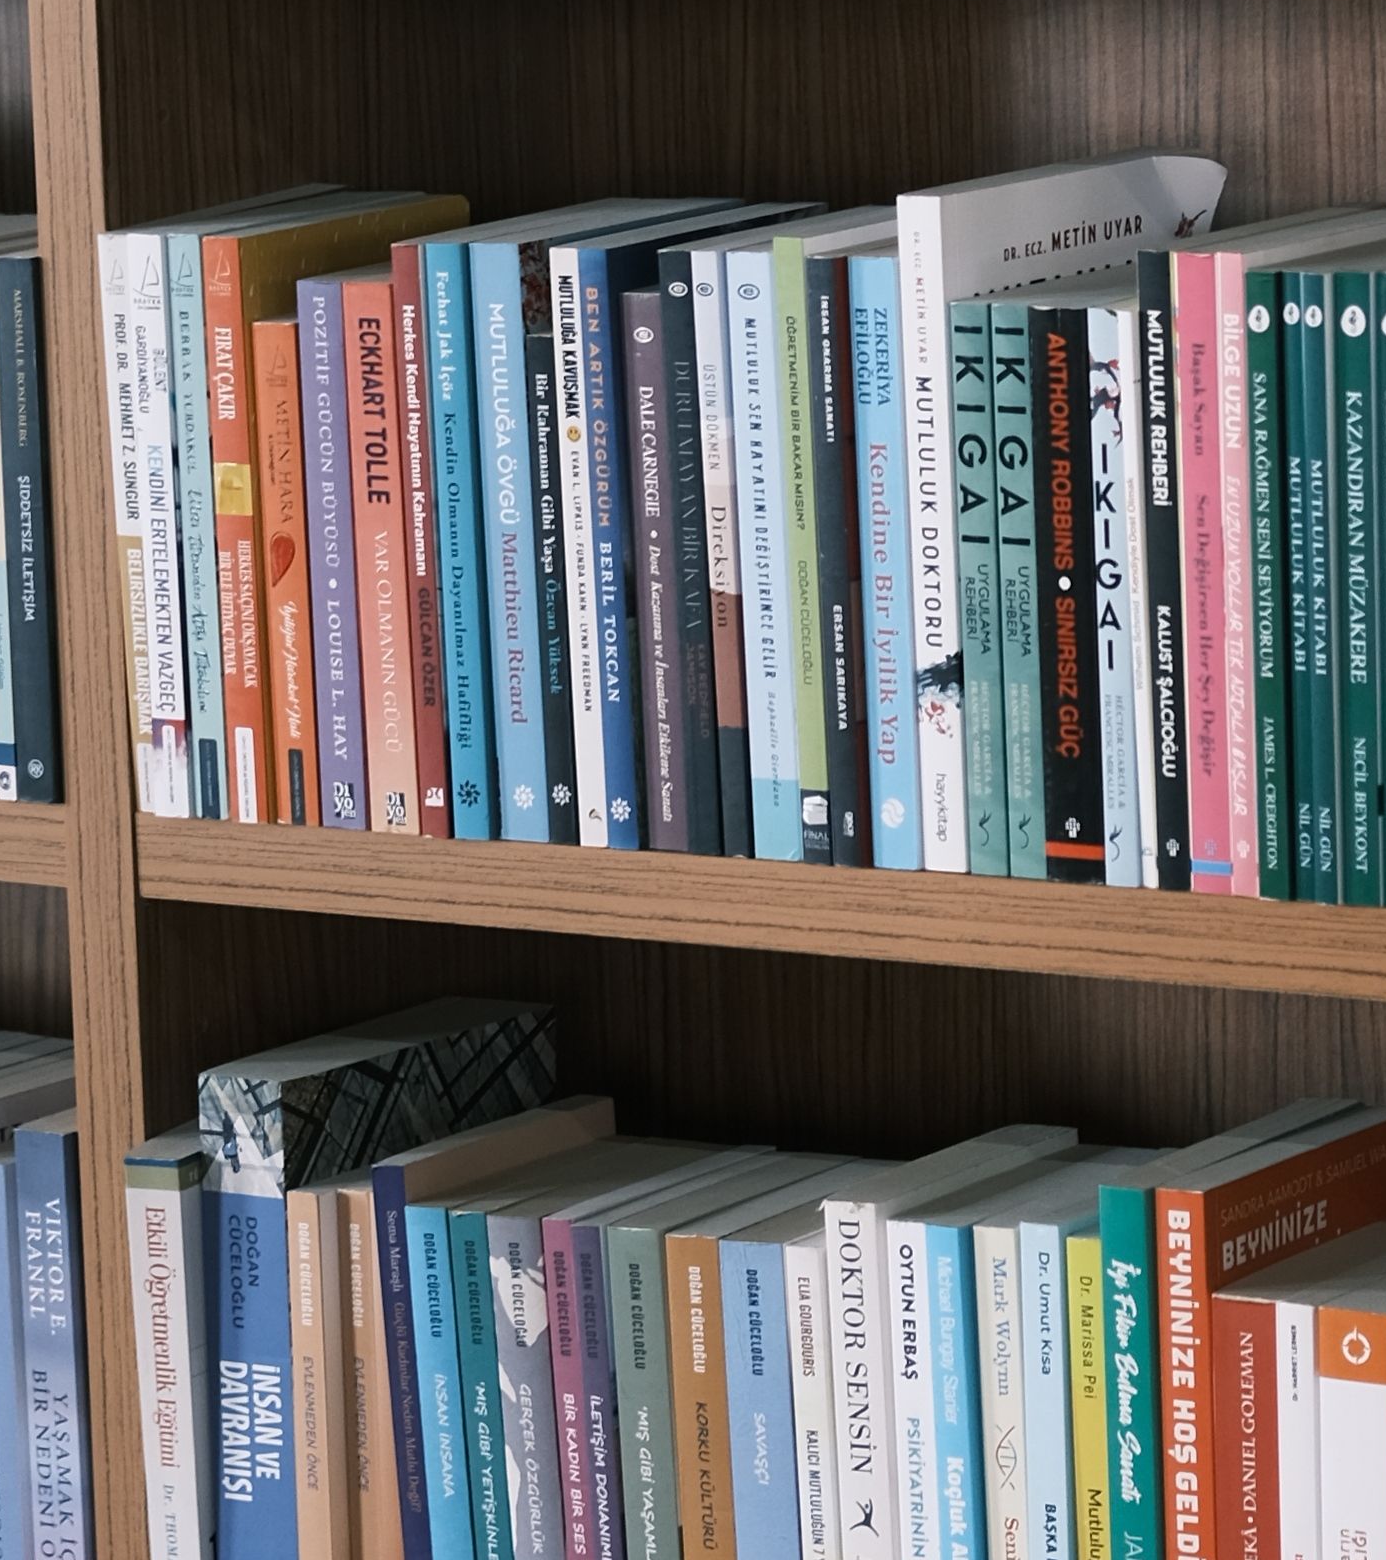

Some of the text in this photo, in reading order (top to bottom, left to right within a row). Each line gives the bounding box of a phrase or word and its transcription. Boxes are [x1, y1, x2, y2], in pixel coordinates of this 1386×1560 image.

[358, 317, 391, 504] ECKHART TOLLE
[487, 302, 522, 525] MUTLULUĞA ÖVGÜ
[1045, 332, 1074, 570] ANTHONY ROBBINS
[16, 475, 38, 622] ŞİDDETSİZ İLETİŞİM
[913, 375, 945, 649] MUTLULUK DOKTORU
[373, 530, 403, 753] VAR OLMANIN GÜCÜ
[499, 531, 530, 724] Matthieu Ricard
[1056, 597, 1082, 759] SINIRSIZ GÜÇ
[932, 772, 953, 842] hayykitap
[24, 1210, 46, 1319] FRANKL
[45, 1198, 66, 1337] VIKTOR E.
[226, 1214, 247, 1330] CÜCELOĞLU
[245, 1217, 262, 1288] DOĞAN
[1166, 1209, 1199, 1388] BEYNİNİZE
[836, 1219, 875, 1476] DOKTOR SENSİN
[1238, 1332, 1259, 1433] GOLEMAN
[218, 1361, 253, 1502] DAVRANIŞI
[249, 1364, 282, 1480] İNSAN VE
[1169, 1399, 1201, 1463] HOŞ
[1239, 1437, 1260, 1514] DANIEL
